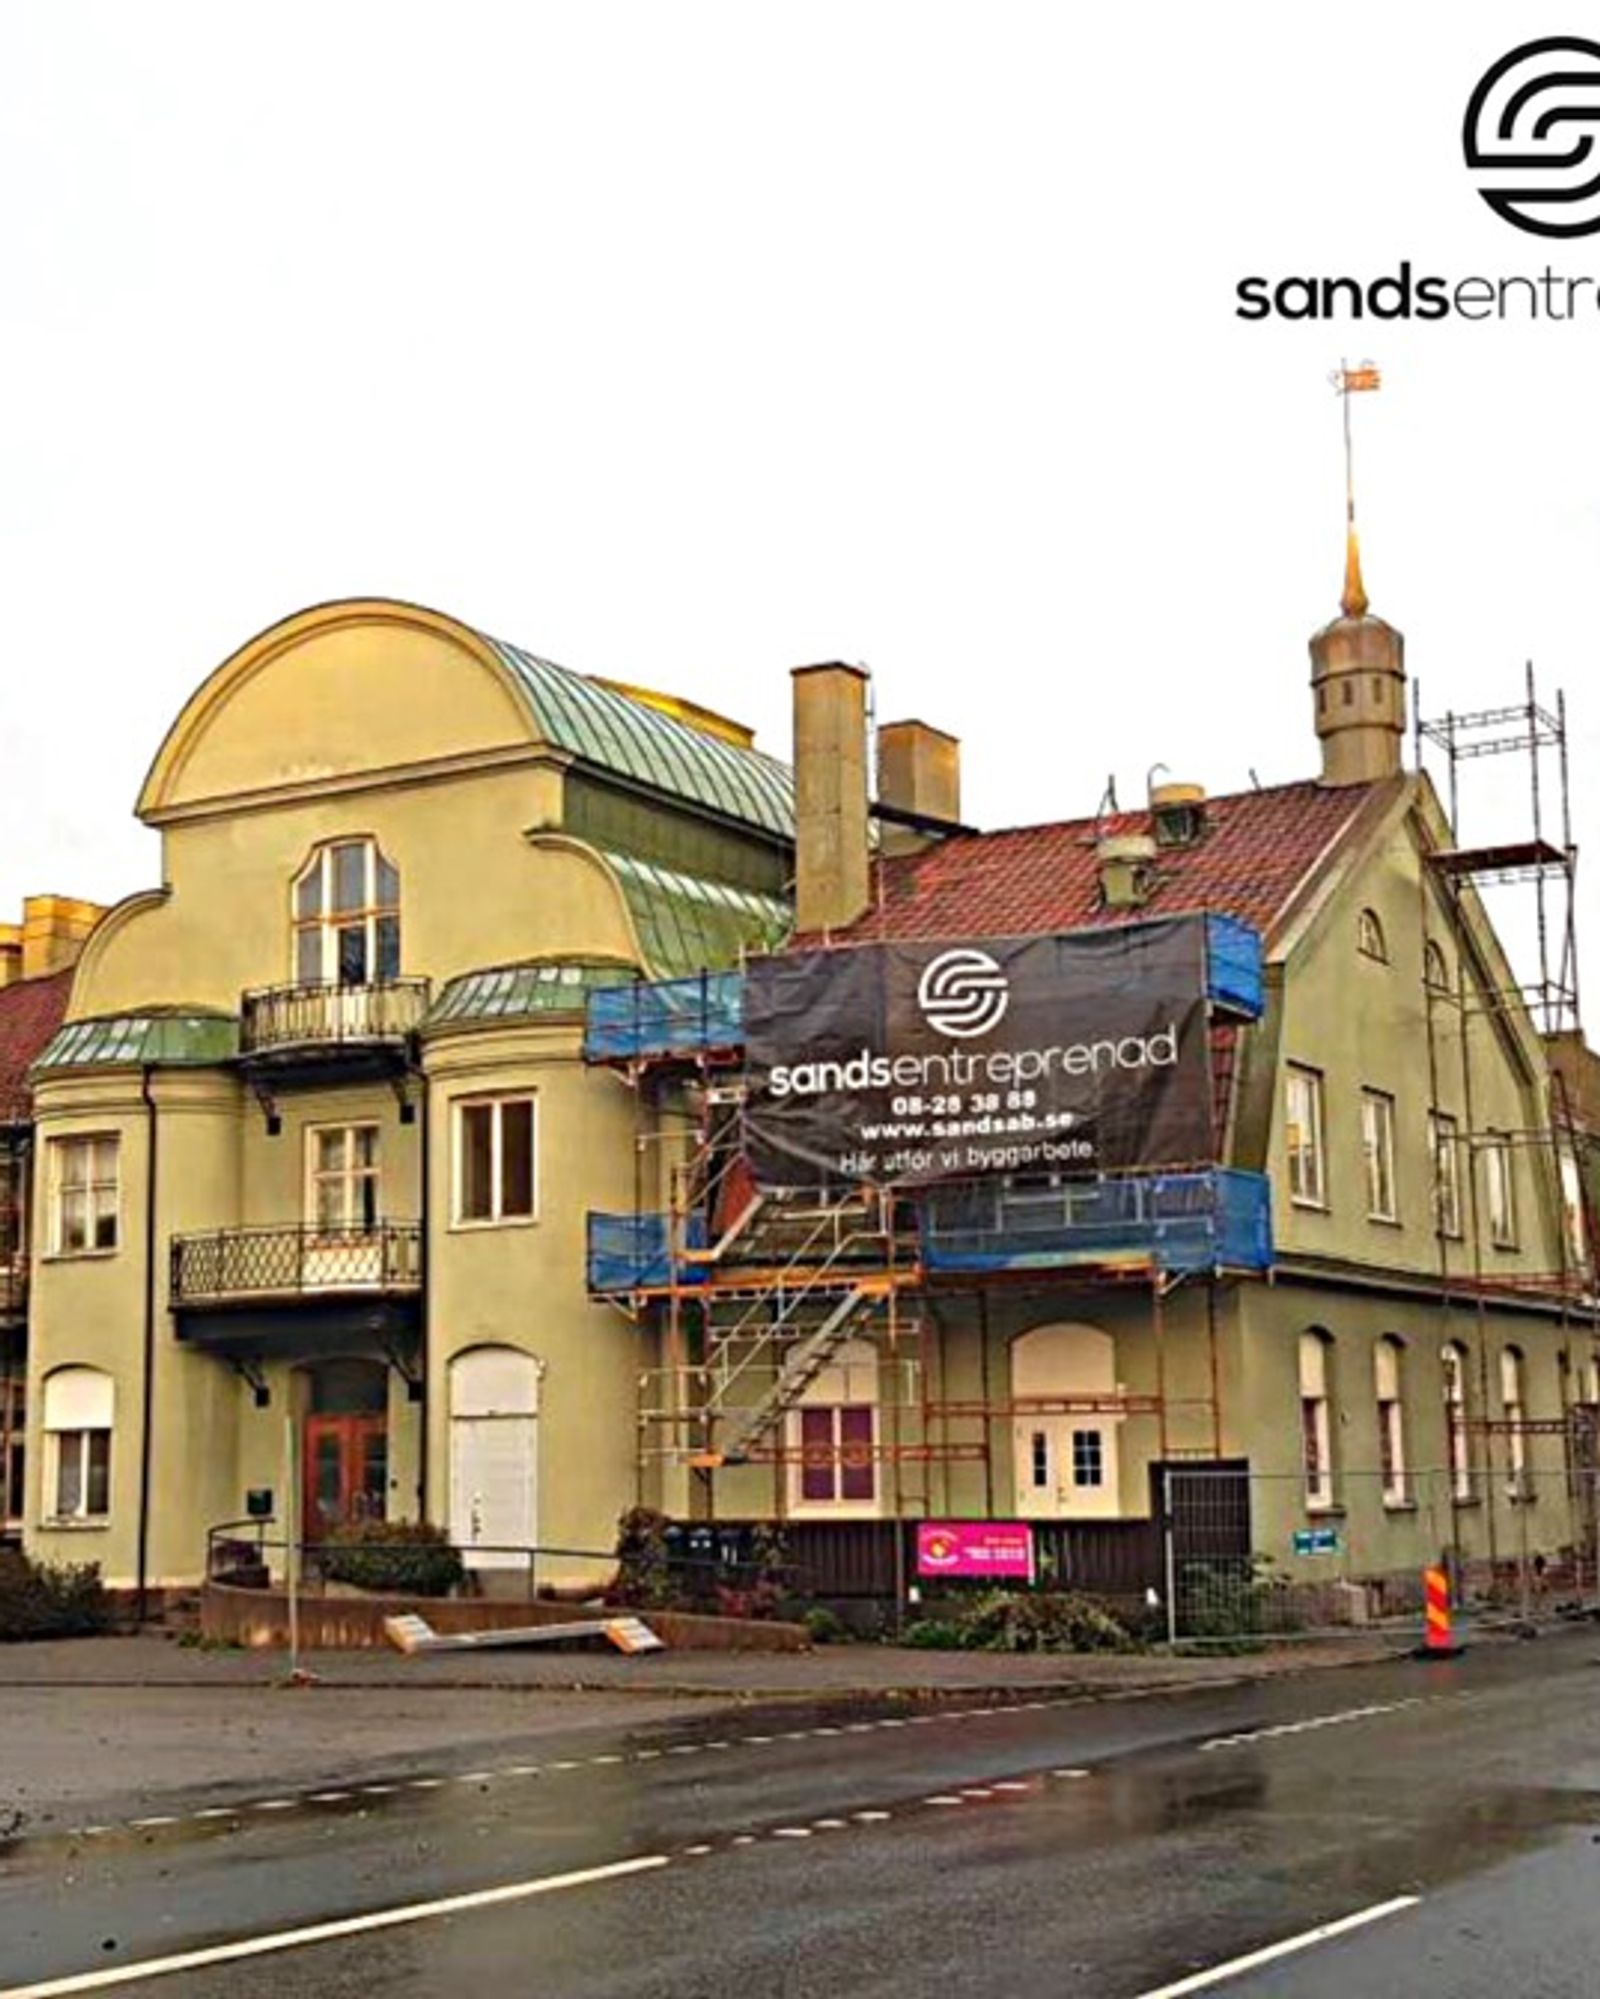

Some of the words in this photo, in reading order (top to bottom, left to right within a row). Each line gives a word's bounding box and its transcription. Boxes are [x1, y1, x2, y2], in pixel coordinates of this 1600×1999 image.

[769, 1024, 1178, 1095] sandsentreprenad
[861, 1113, 1074, 1140] www.sandsab.se
[940, 1148, 958, 1168] vi
